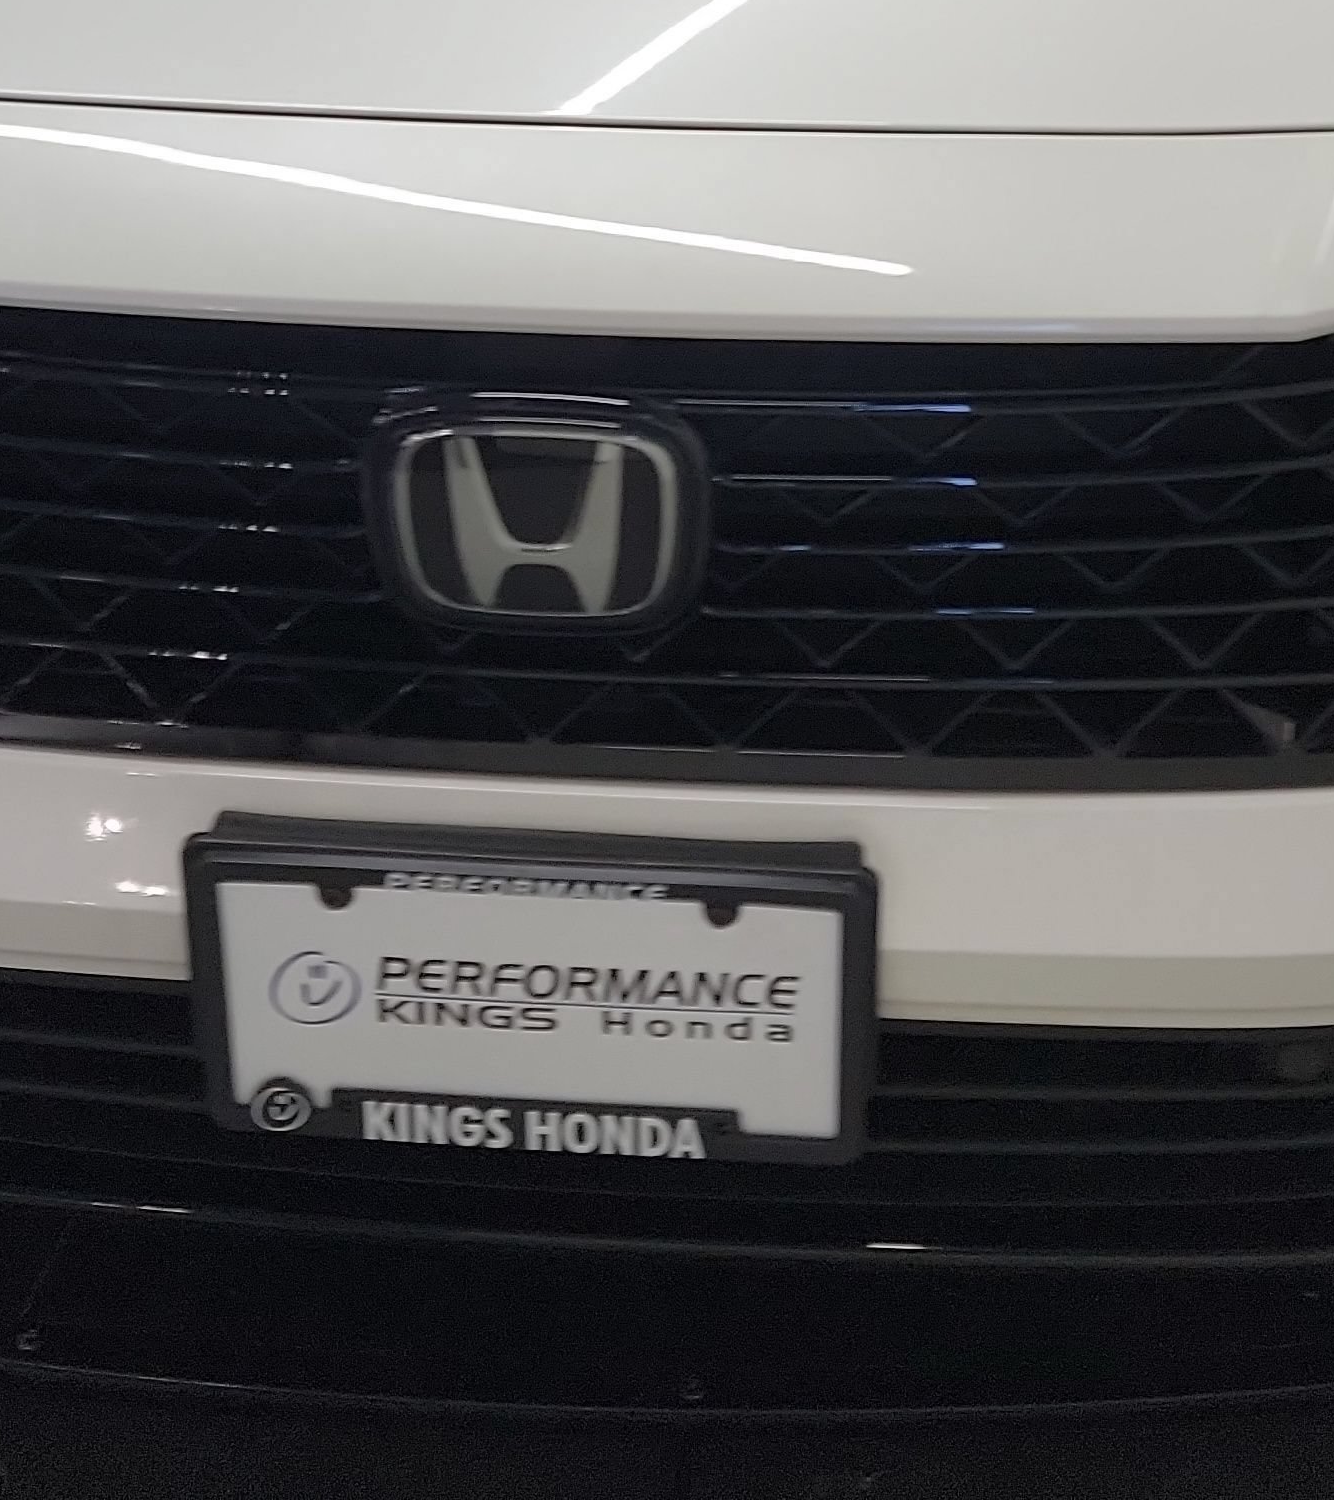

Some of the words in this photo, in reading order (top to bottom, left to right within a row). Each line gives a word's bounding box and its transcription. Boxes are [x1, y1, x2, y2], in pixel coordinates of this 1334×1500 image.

[376, 955, 803, 1011] PERFORMANCE
[377, 999, 560, 1033] KINGS
[600, 1010, 795, 1044] Honda
[362, 1100, 514, 1150] KINGS
[523, 1109, 707, 1160] HONDA
